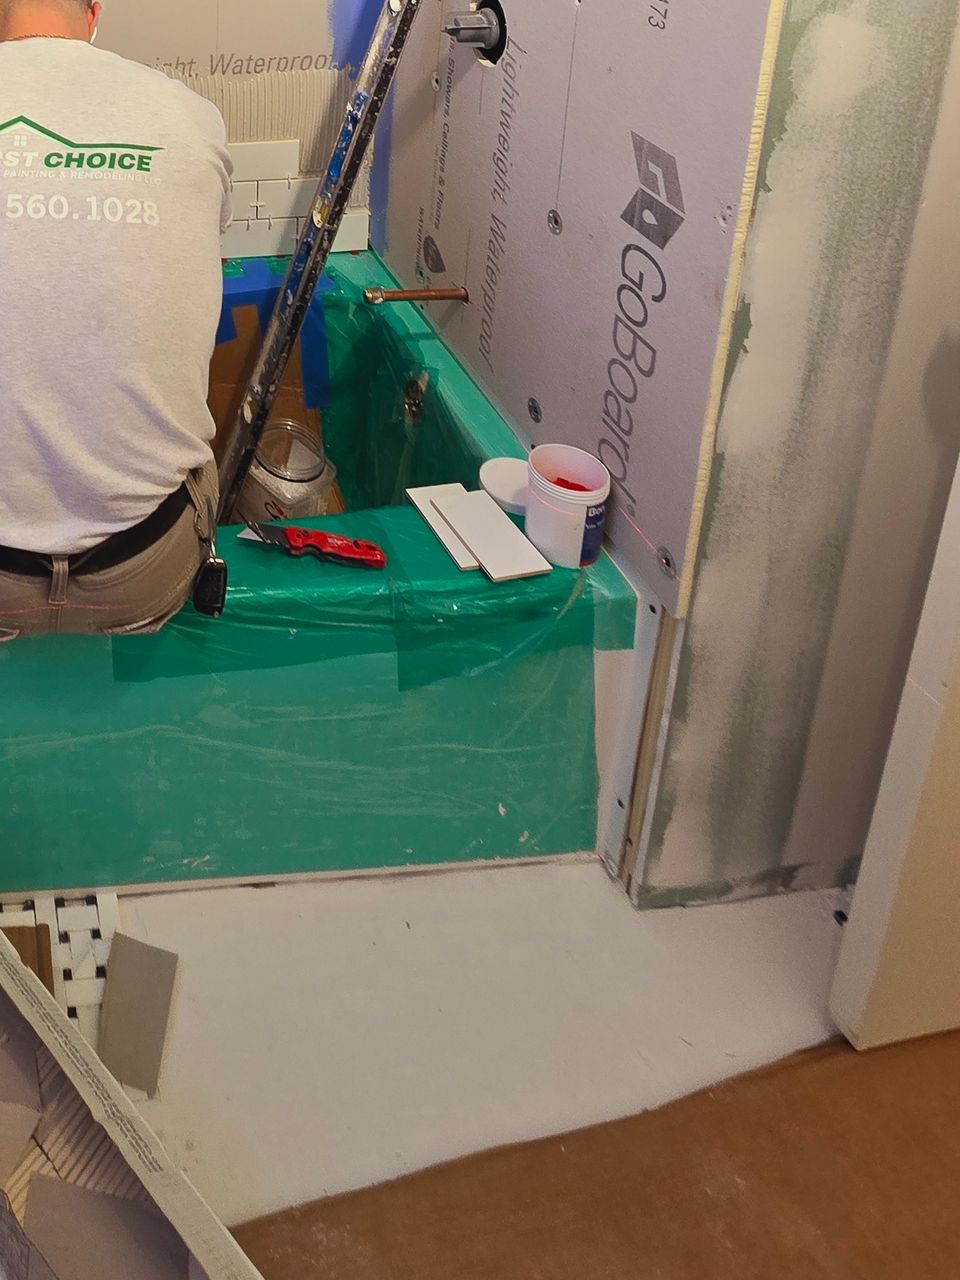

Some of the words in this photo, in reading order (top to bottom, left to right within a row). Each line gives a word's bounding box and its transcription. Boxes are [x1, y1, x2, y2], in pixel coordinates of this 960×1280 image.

[43, 151, 153, 173] CHOICE
[3, 169, 56, 180] PAINTING
[59, 170, 67, 180] &
[69, 170, 142, 183] REMODELING
